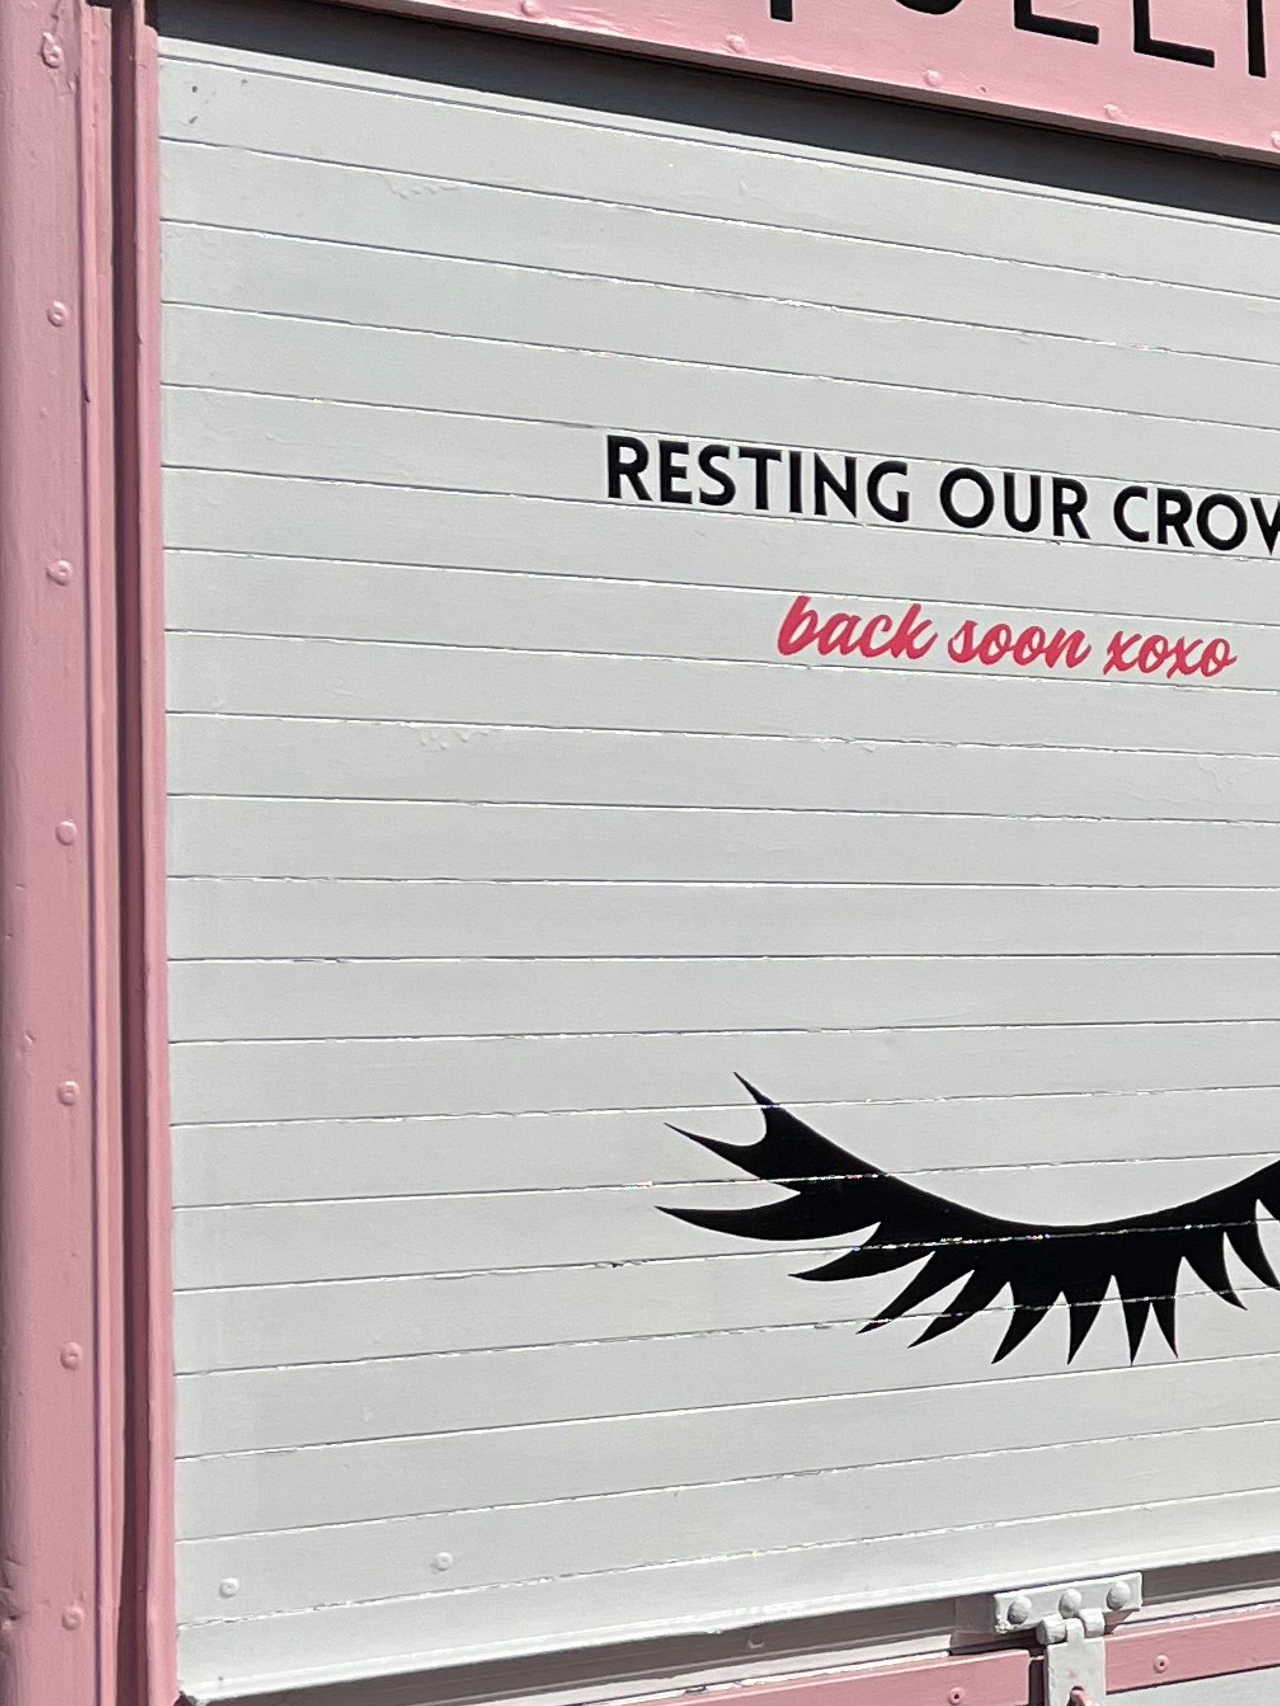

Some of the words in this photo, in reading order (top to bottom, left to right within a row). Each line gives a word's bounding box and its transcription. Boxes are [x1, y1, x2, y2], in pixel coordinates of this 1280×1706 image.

[606, 434, 910, 523] RESTING
[939, 467, 1090, 540] OUR
[776, 593, 938, 661] back
[947, 619, 1091, 669] soon
[1102, 631, 1237, 678] xoxo
